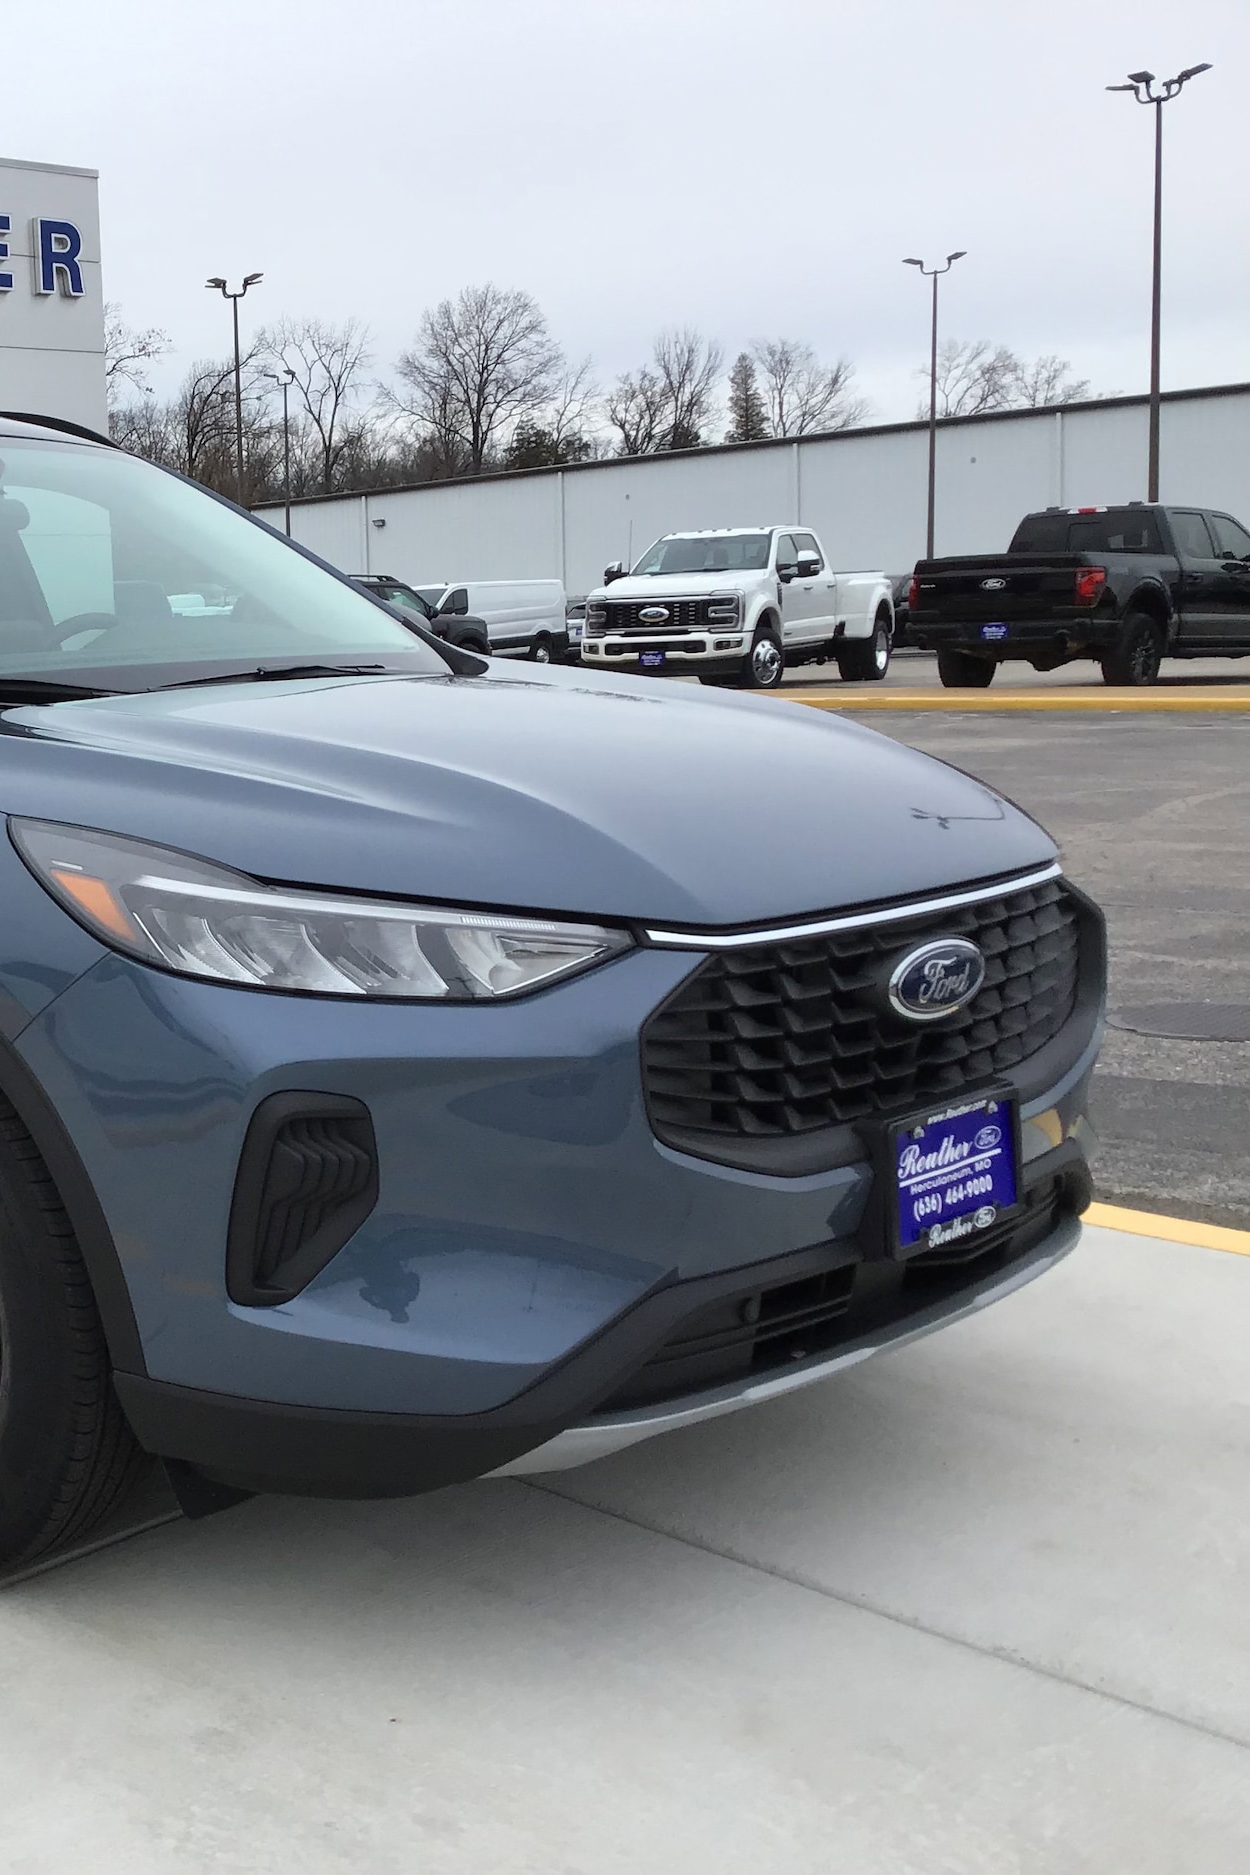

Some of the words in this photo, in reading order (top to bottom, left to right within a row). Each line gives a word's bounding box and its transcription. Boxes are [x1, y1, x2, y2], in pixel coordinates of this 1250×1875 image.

[918, 956, 970, 1004] Ford
[898, 1134, 972, 1179] Reuther
[975, 1158, 991, 1172] MO
[913, 1192, 942, 1222] (636)
[945, 1174, 993, 1205] 464-9000
